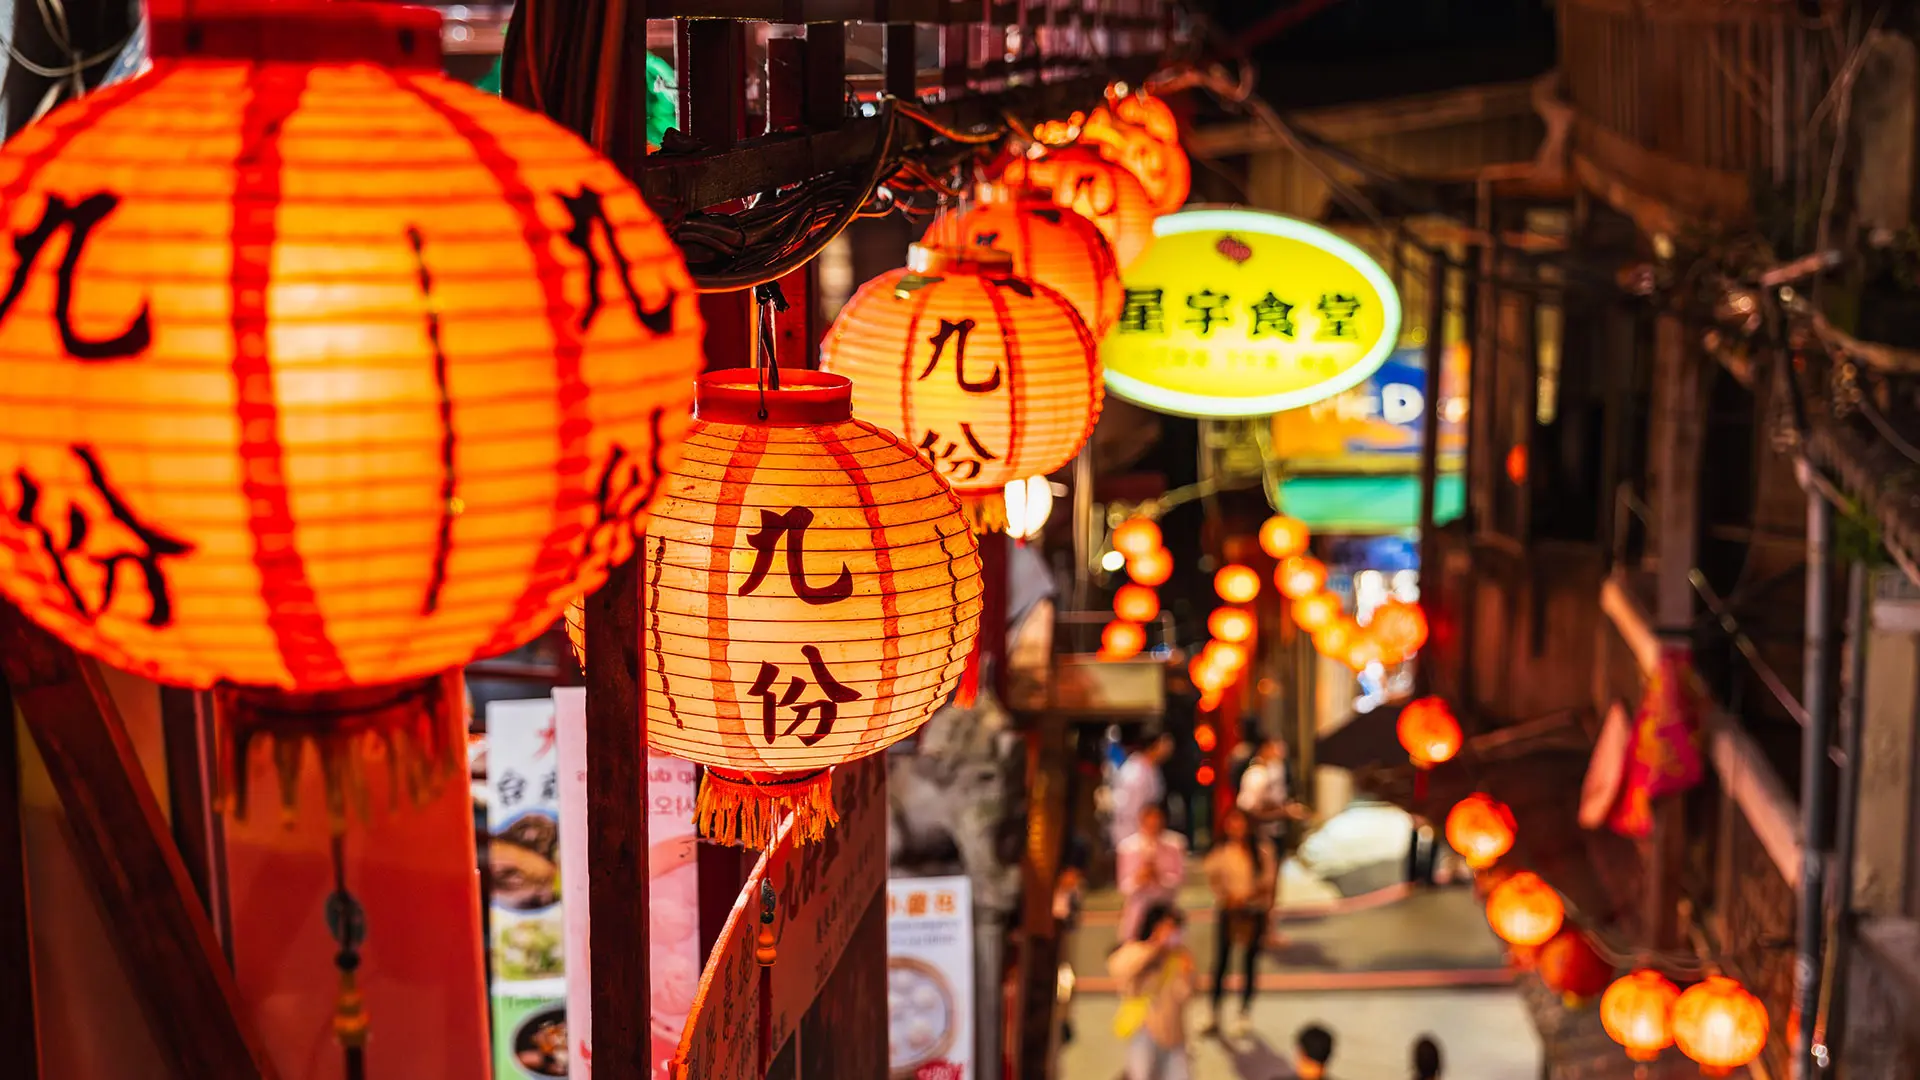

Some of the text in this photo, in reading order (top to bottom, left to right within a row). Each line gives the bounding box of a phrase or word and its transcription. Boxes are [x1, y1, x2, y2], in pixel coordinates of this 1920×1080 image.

[0, 192, 197, 626] 九份
[917, 318, 1000, 480] 九份
[737, 505, 862, 747] 九份
